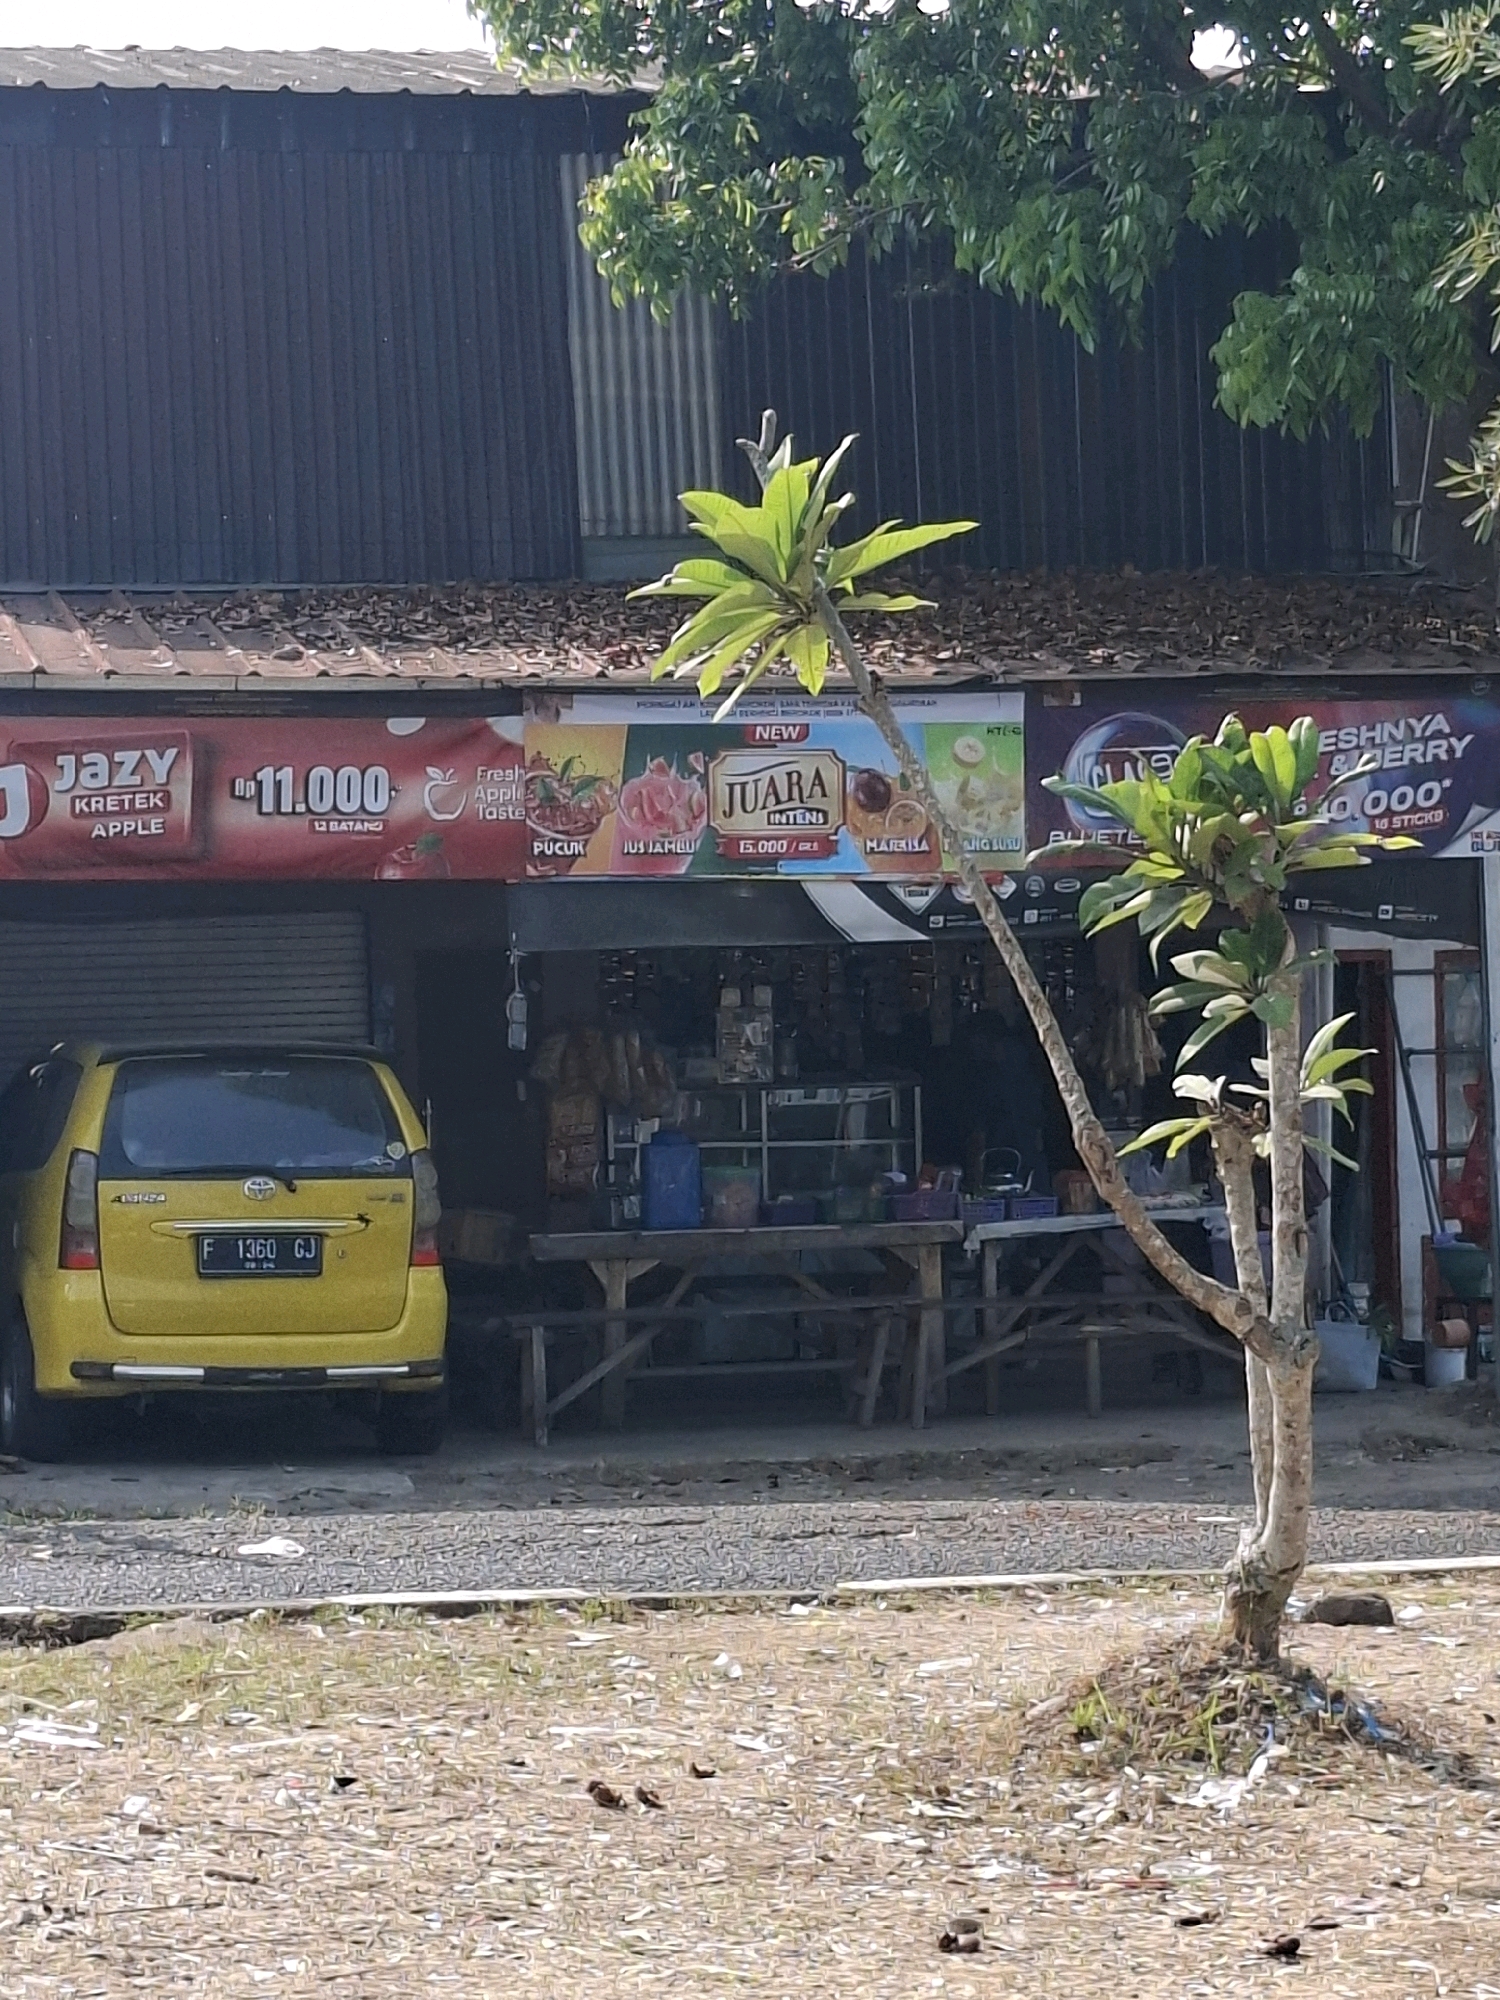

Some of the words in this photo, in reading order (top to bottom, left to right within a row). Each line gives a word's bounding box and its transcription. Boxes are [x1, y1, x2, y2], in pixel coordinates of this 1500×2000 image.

[755, 725, 801, 740] NEW
[722, 766, 830, 819] JUARA
[75, 793, 164, 814] KRETEK
[476, 804, 525, 820] Taste
[91, 818, 164, 839] APPLE
[203, 1238, 214, 1260] F
[237, 1238, 276, 1259] 1360
[294, 1237, 316, 1259] GJ
